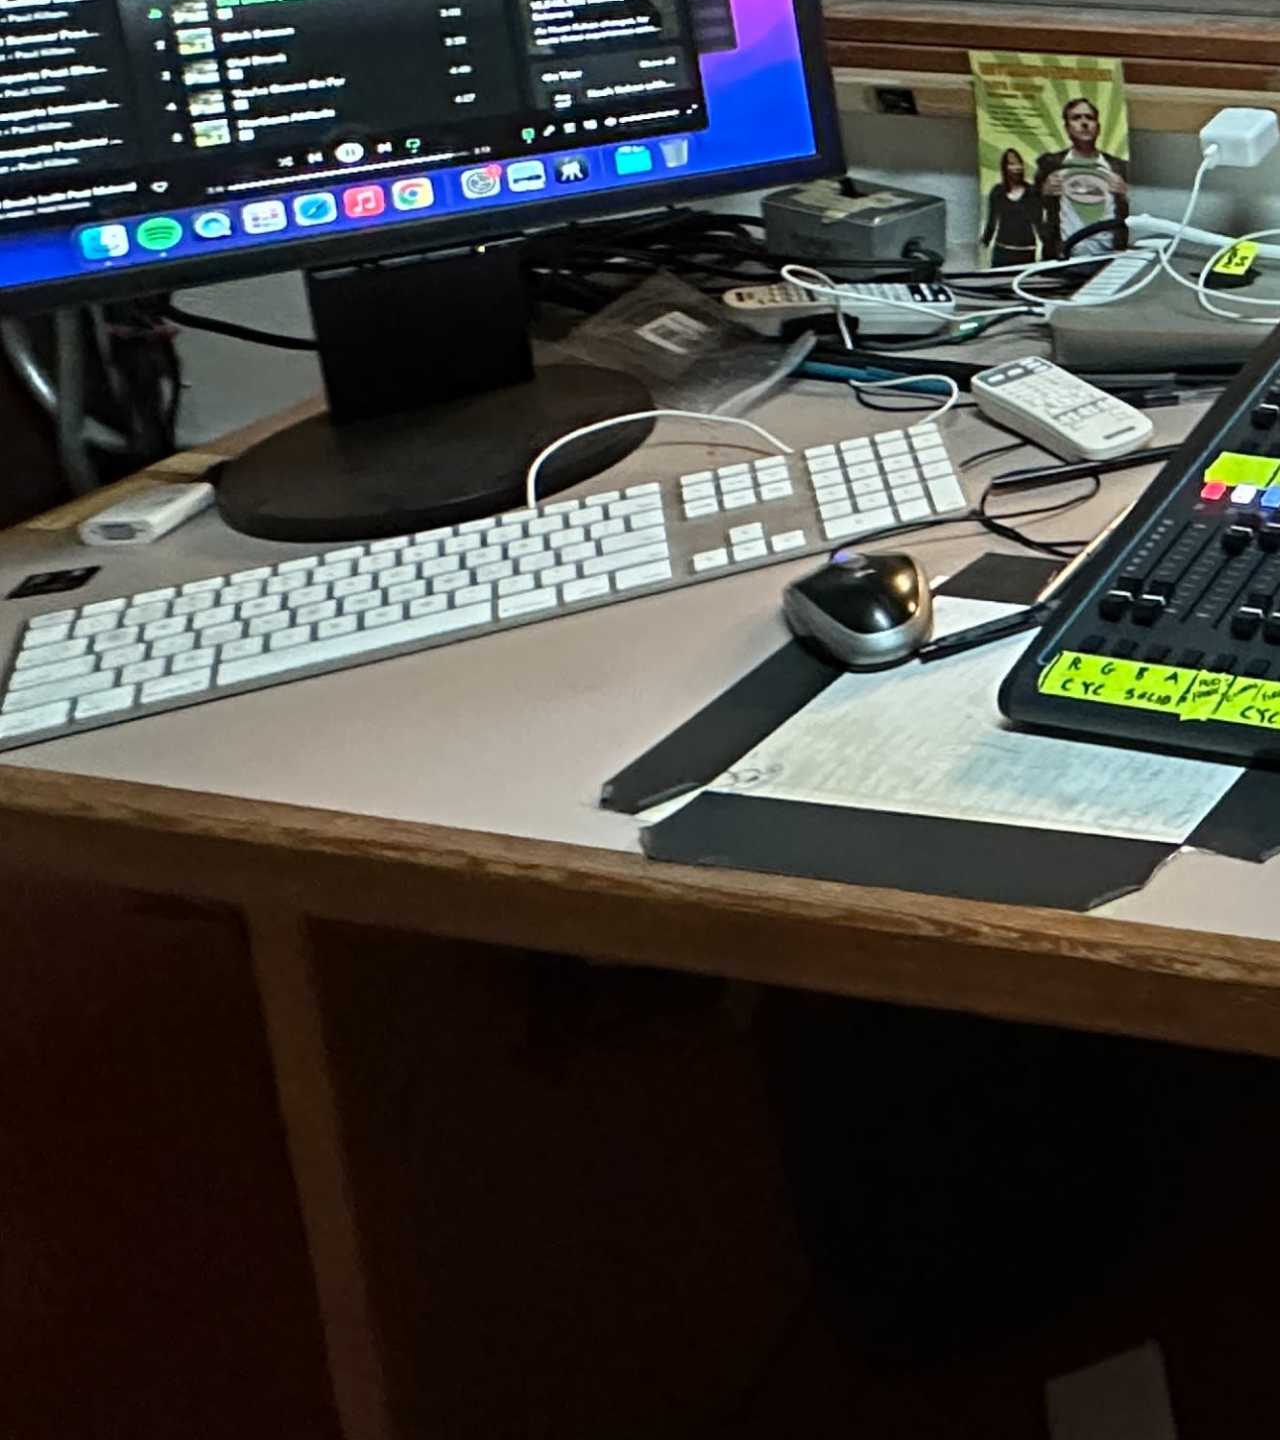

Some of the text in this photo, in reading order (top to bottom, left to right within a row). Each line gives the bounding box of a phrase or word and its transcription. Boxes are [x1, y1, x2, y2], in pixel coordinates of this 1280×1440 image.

[1068, 656, 1082, 671] R
[1101, 662, 1116, 675] G
[1164, 671, 1179, 685] A
[1240, 705, 1280, 724] CYC
